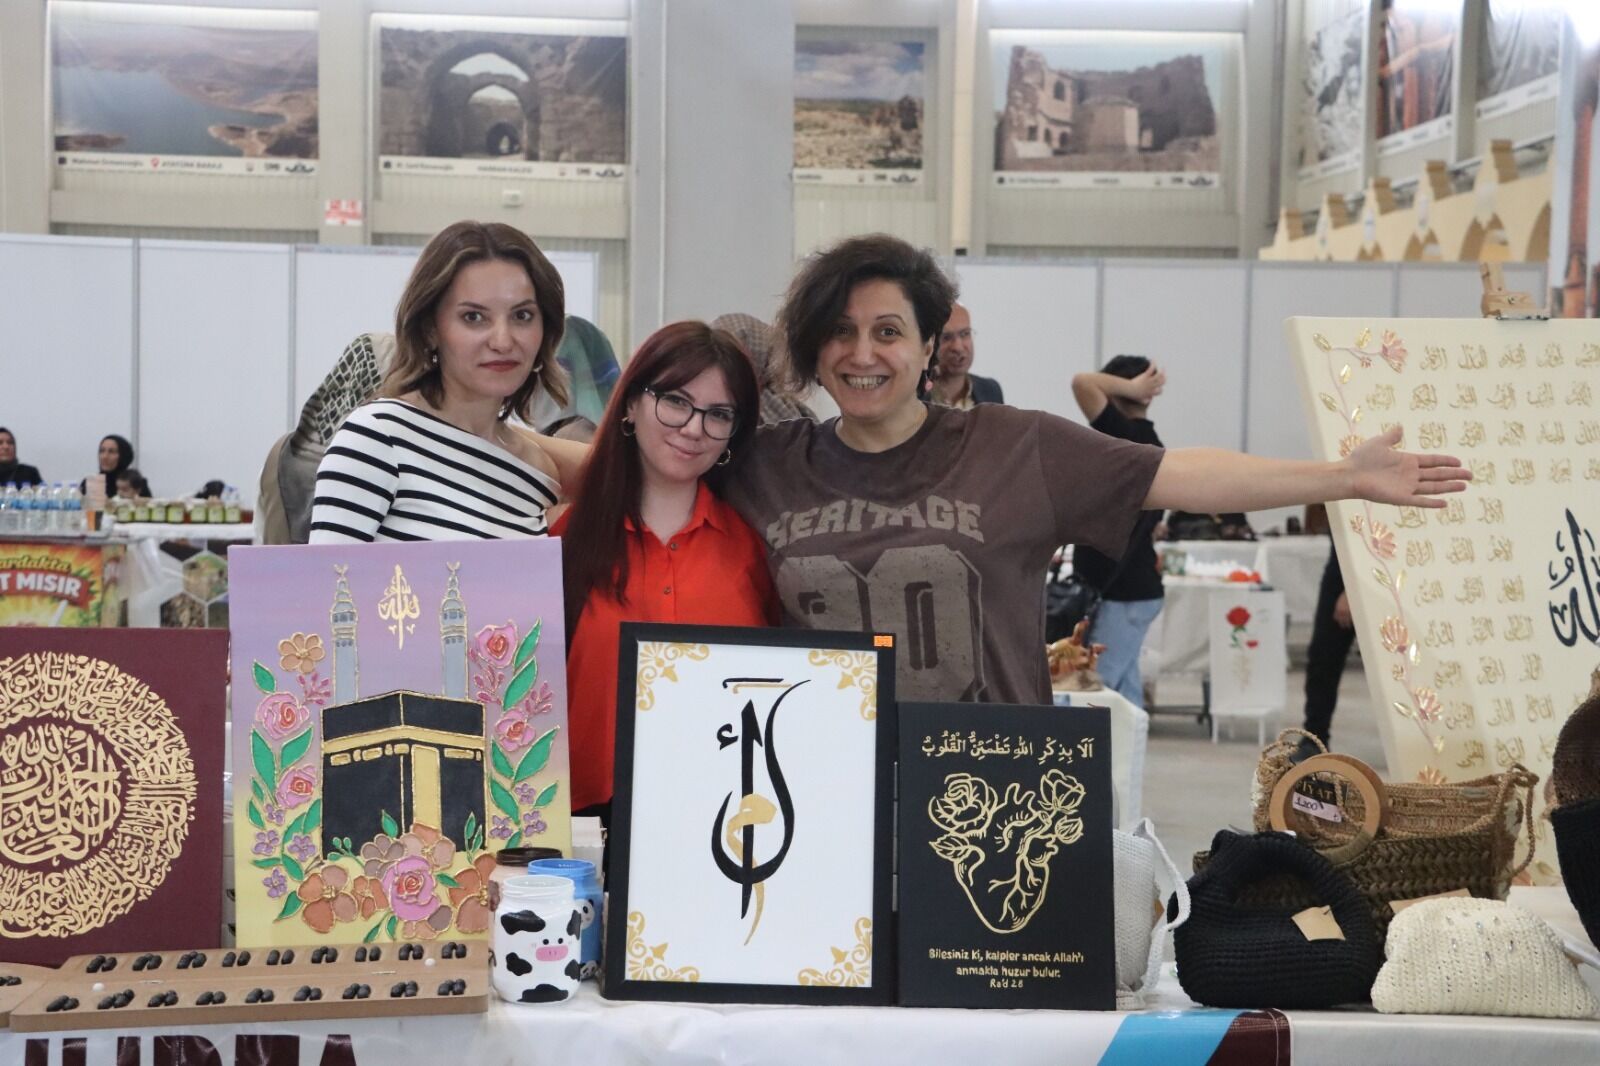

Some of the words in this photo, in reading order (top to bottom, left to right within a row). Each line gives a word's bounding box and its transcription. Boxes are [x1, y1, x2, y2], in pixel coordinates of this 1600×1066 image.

[766, 495, 985, 549] HERITAGE
[16, 572, 82, 598] MISIR
[928, 948, 970, 960] Bilesiniz
[1022, 952, 1051, 962] ancak
[1001, 966, 1031, 977] huzur
